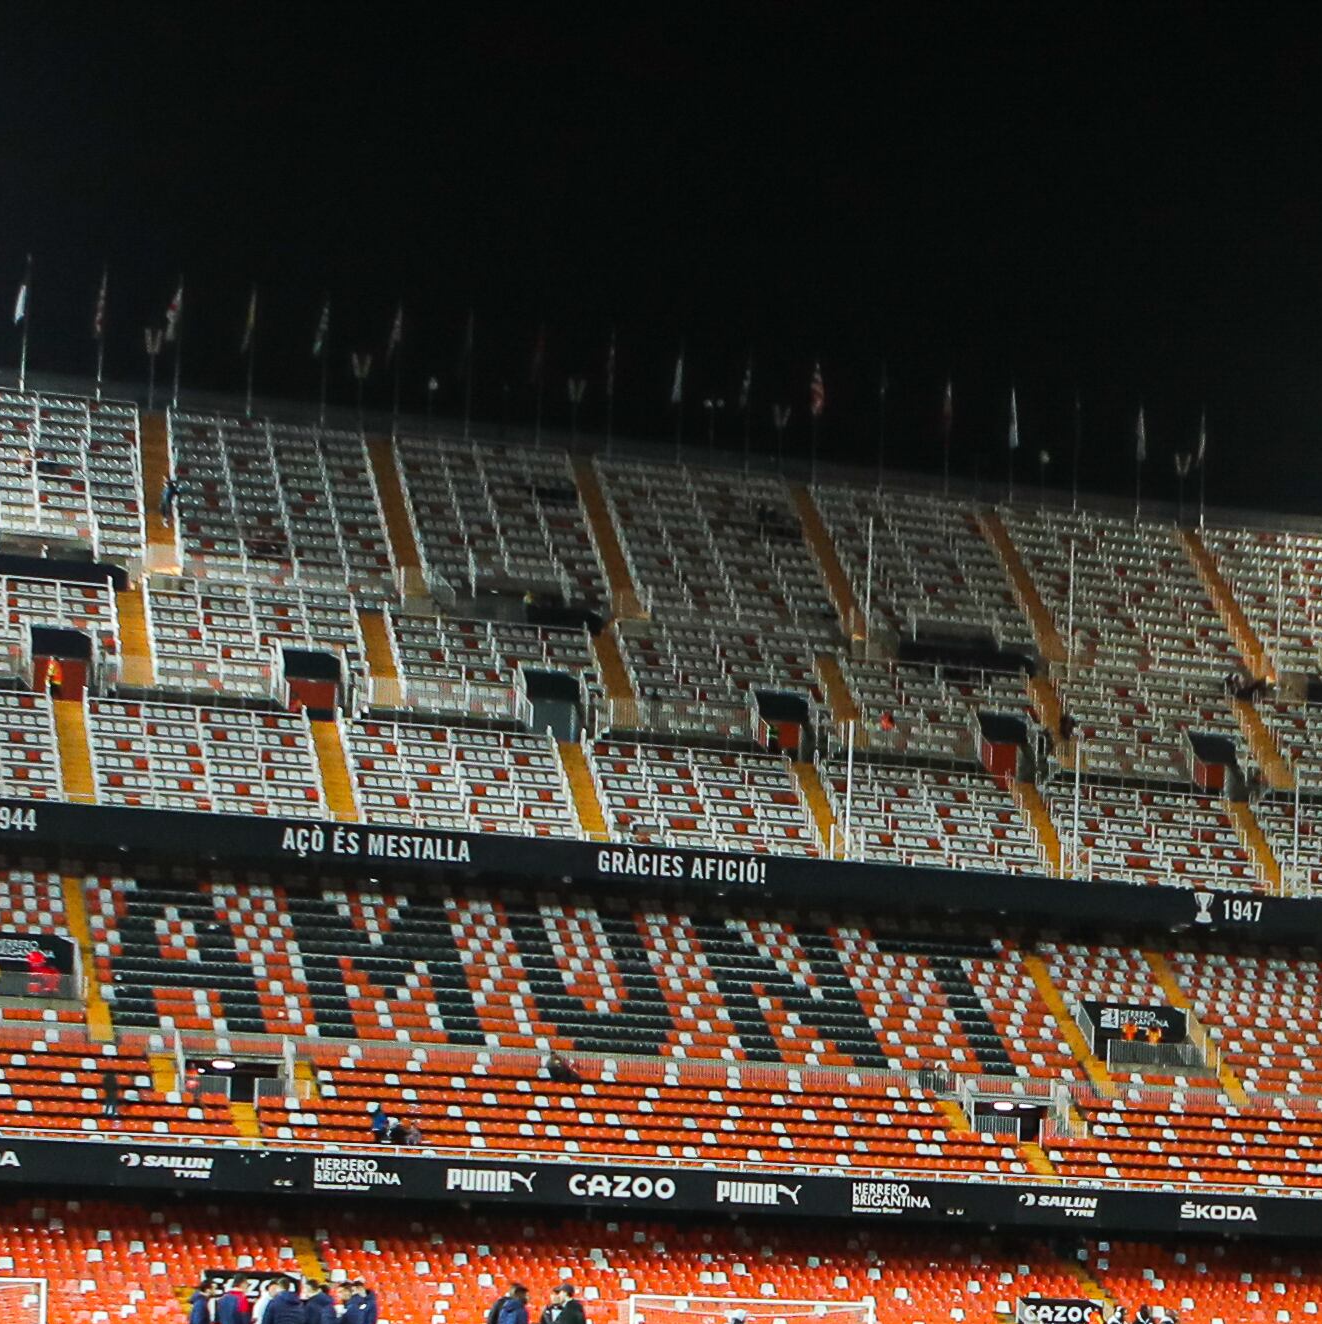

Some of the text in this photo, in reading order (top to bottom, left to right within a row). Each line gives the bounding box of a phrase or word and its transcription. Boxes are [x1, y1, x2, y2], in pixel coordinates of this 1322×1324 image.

[282, 826, 471, 864] AÇÒ ÉS MESTALLA
[597, 849, 767, 884] GRÀCIES AFICIÓ!
[1223, 900, 1263, 922] 1947
[142, 1154, 214, 1169] SAILUN
[314, 1158, 378, 1173] HERRERO
[174, 1169, 210, 1179] TYRE
[314, 1170, 402, 1186] BRIGANTINA
[446, 1168, 512, 1192] PUMA
[568, 1174, 676, 1199] CAZOO
[716, 1180, 778, 1205] PUMA
[852, 1182, 910, 1197] HERRERO
[852, 1194, 931, 1209] BRIGANTINA
[1038, 1195, 1098, 1209] SAILUN
[1064, 1208, 1095, 1218] TYRE
[1180, 1201, 1258, 1221] ŠKODA
